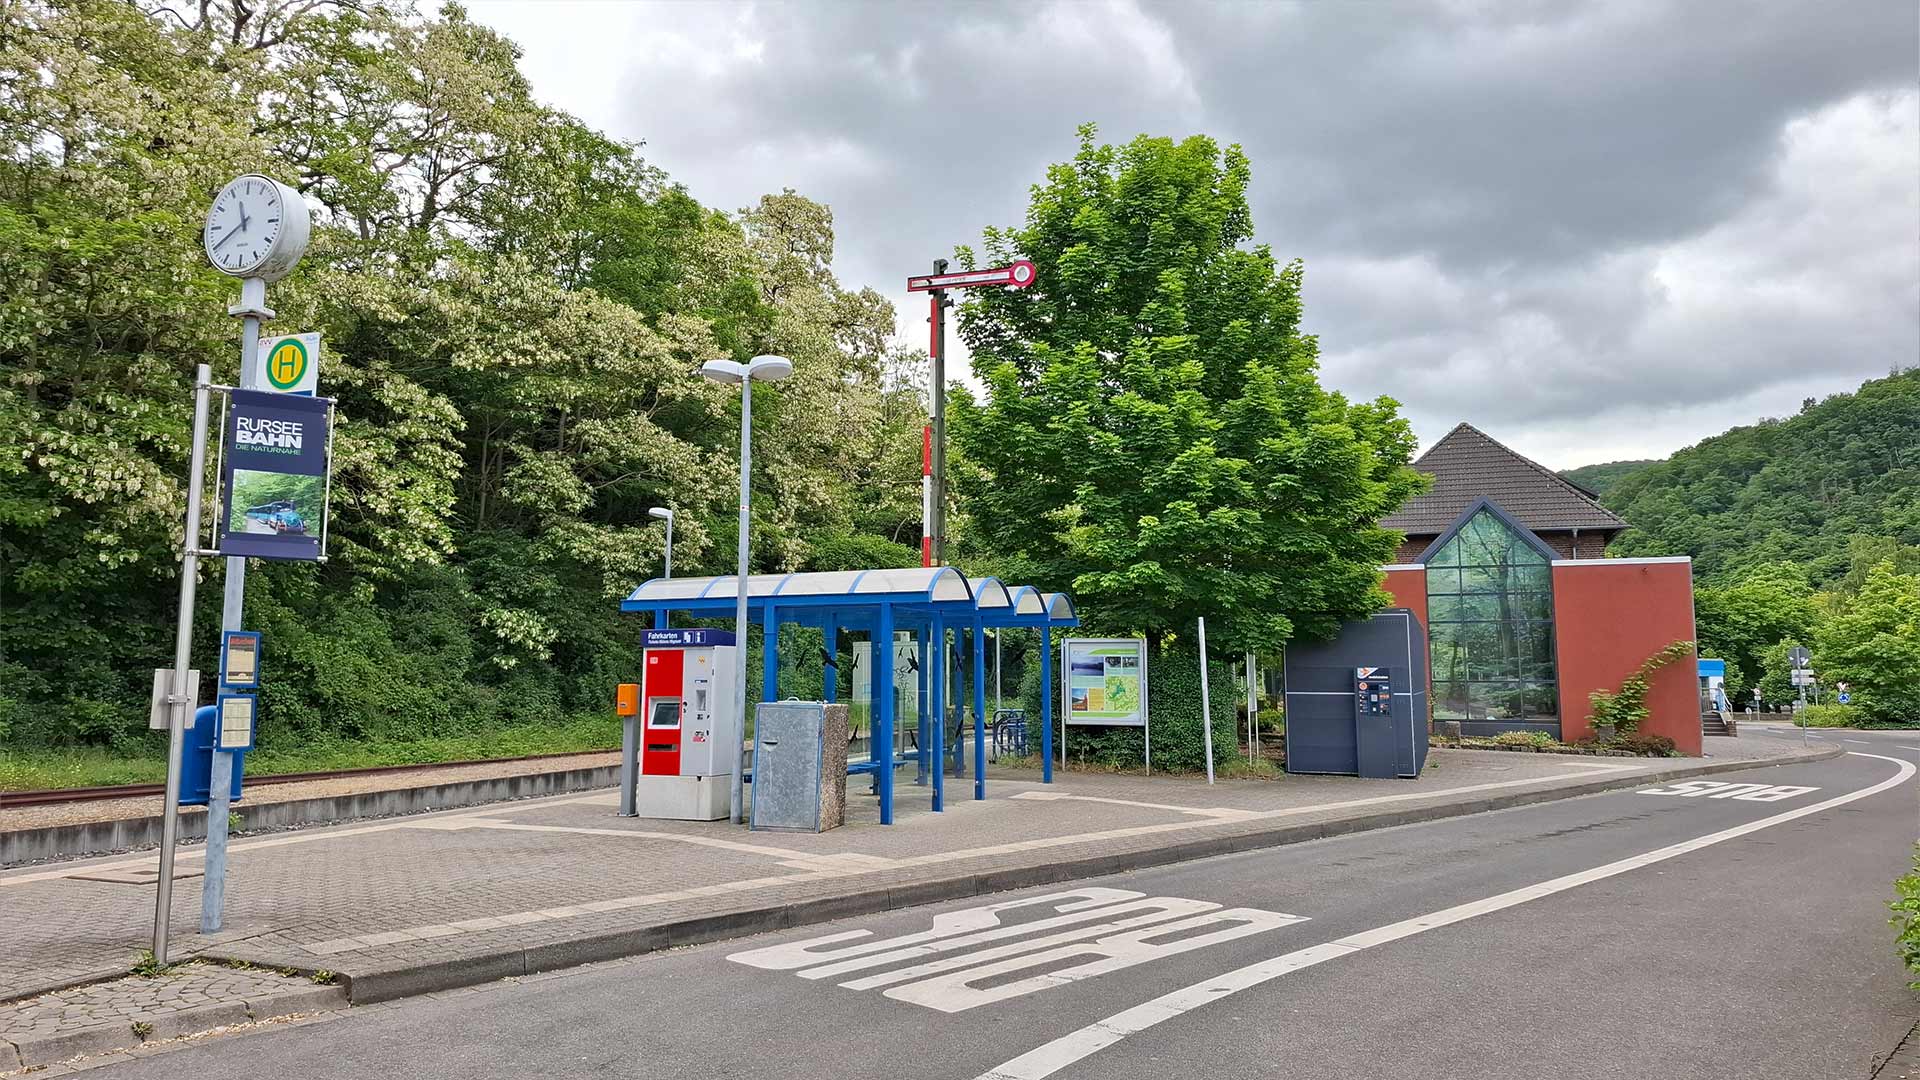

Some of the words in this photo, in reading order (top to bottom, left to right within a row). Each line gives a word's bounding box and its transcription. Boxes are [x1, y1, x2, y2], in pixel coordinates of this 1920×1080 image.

[278, 350, 297, 379] H
[237, 416, 303, 436] RURSEE
[236, 430, 302, 449] BAHN
[250, 445, 302, 456] NATURNAHE
[1635, 780, 1823, 802] BUS
[726, 887, 1312, 1013] BUS
